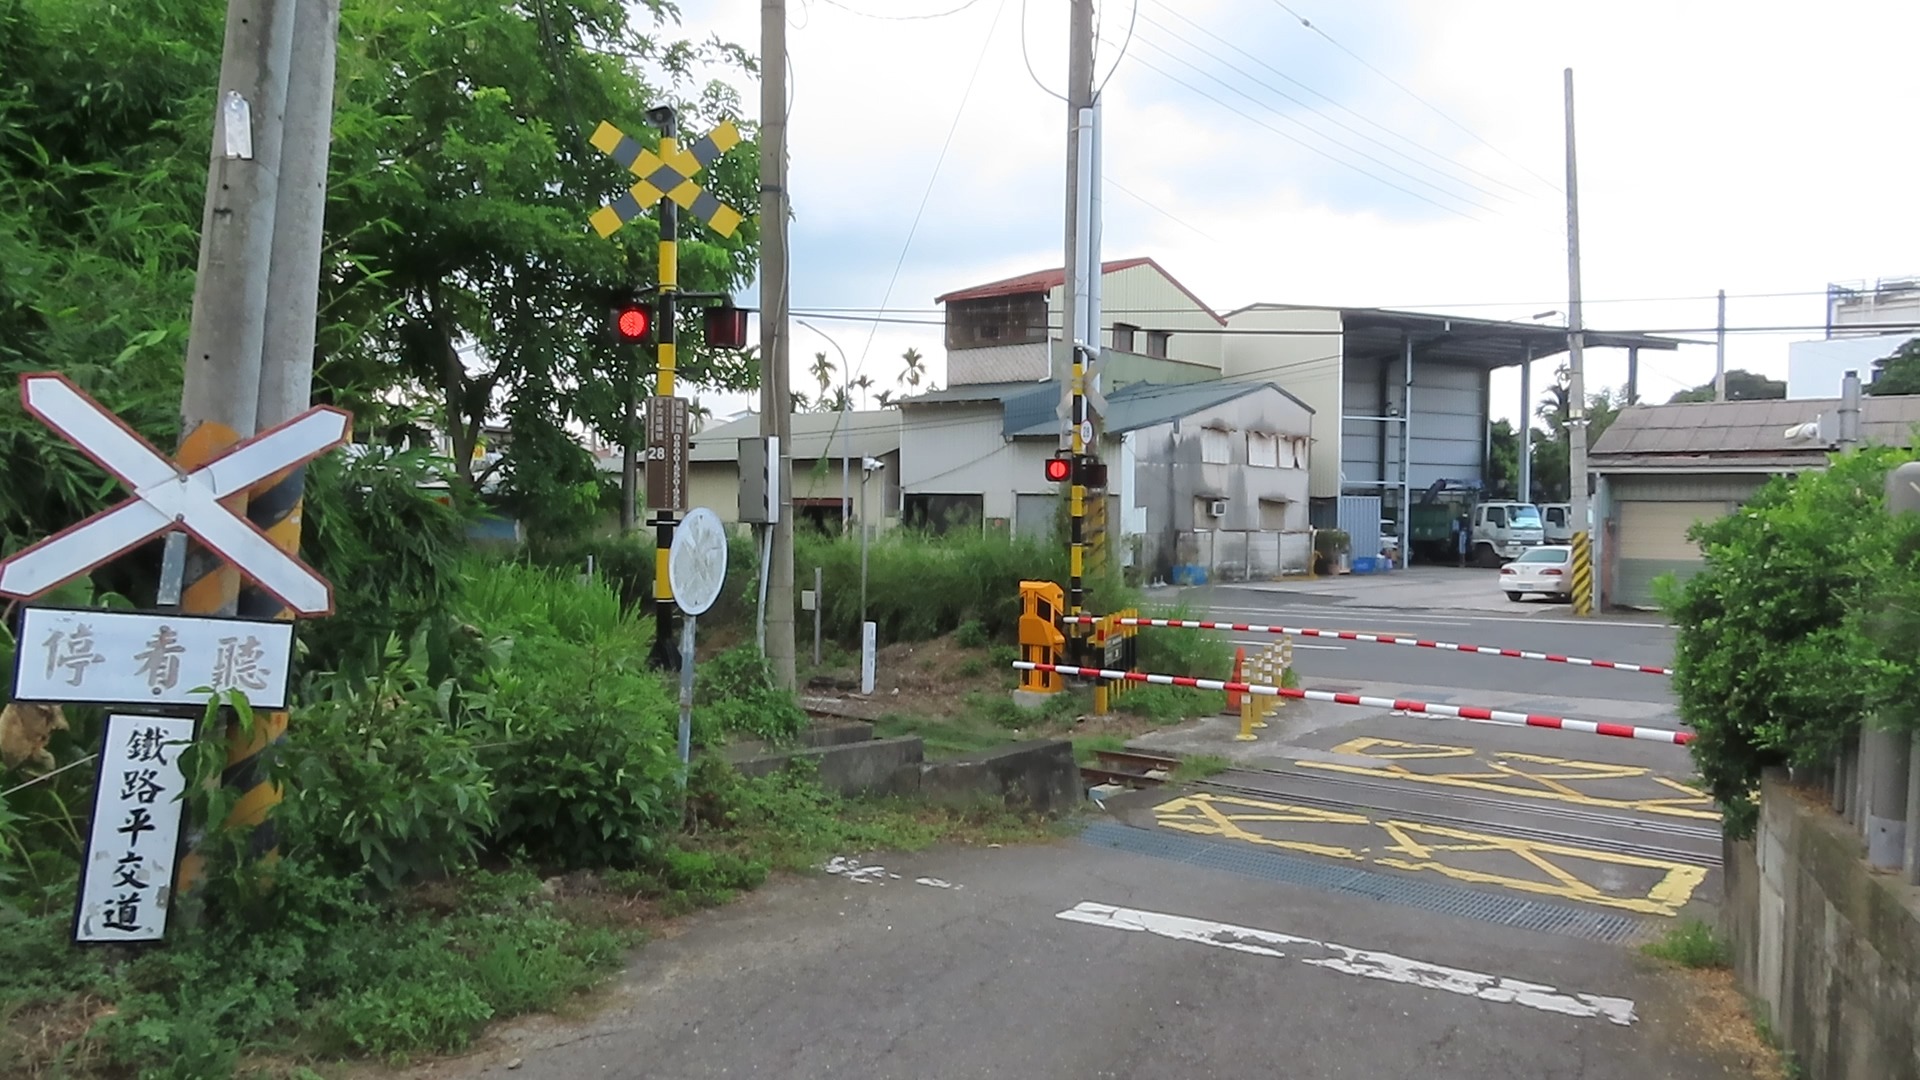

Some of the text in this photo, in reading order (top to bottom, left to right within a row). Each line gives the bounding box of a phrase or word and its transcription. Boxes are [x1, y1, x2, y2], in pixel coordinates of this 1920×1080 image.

[648, 447, 665, 460] 28
[42, 622, 271, 691] 停看聽
[102, 726, 169, 932] 鐵路平交道
